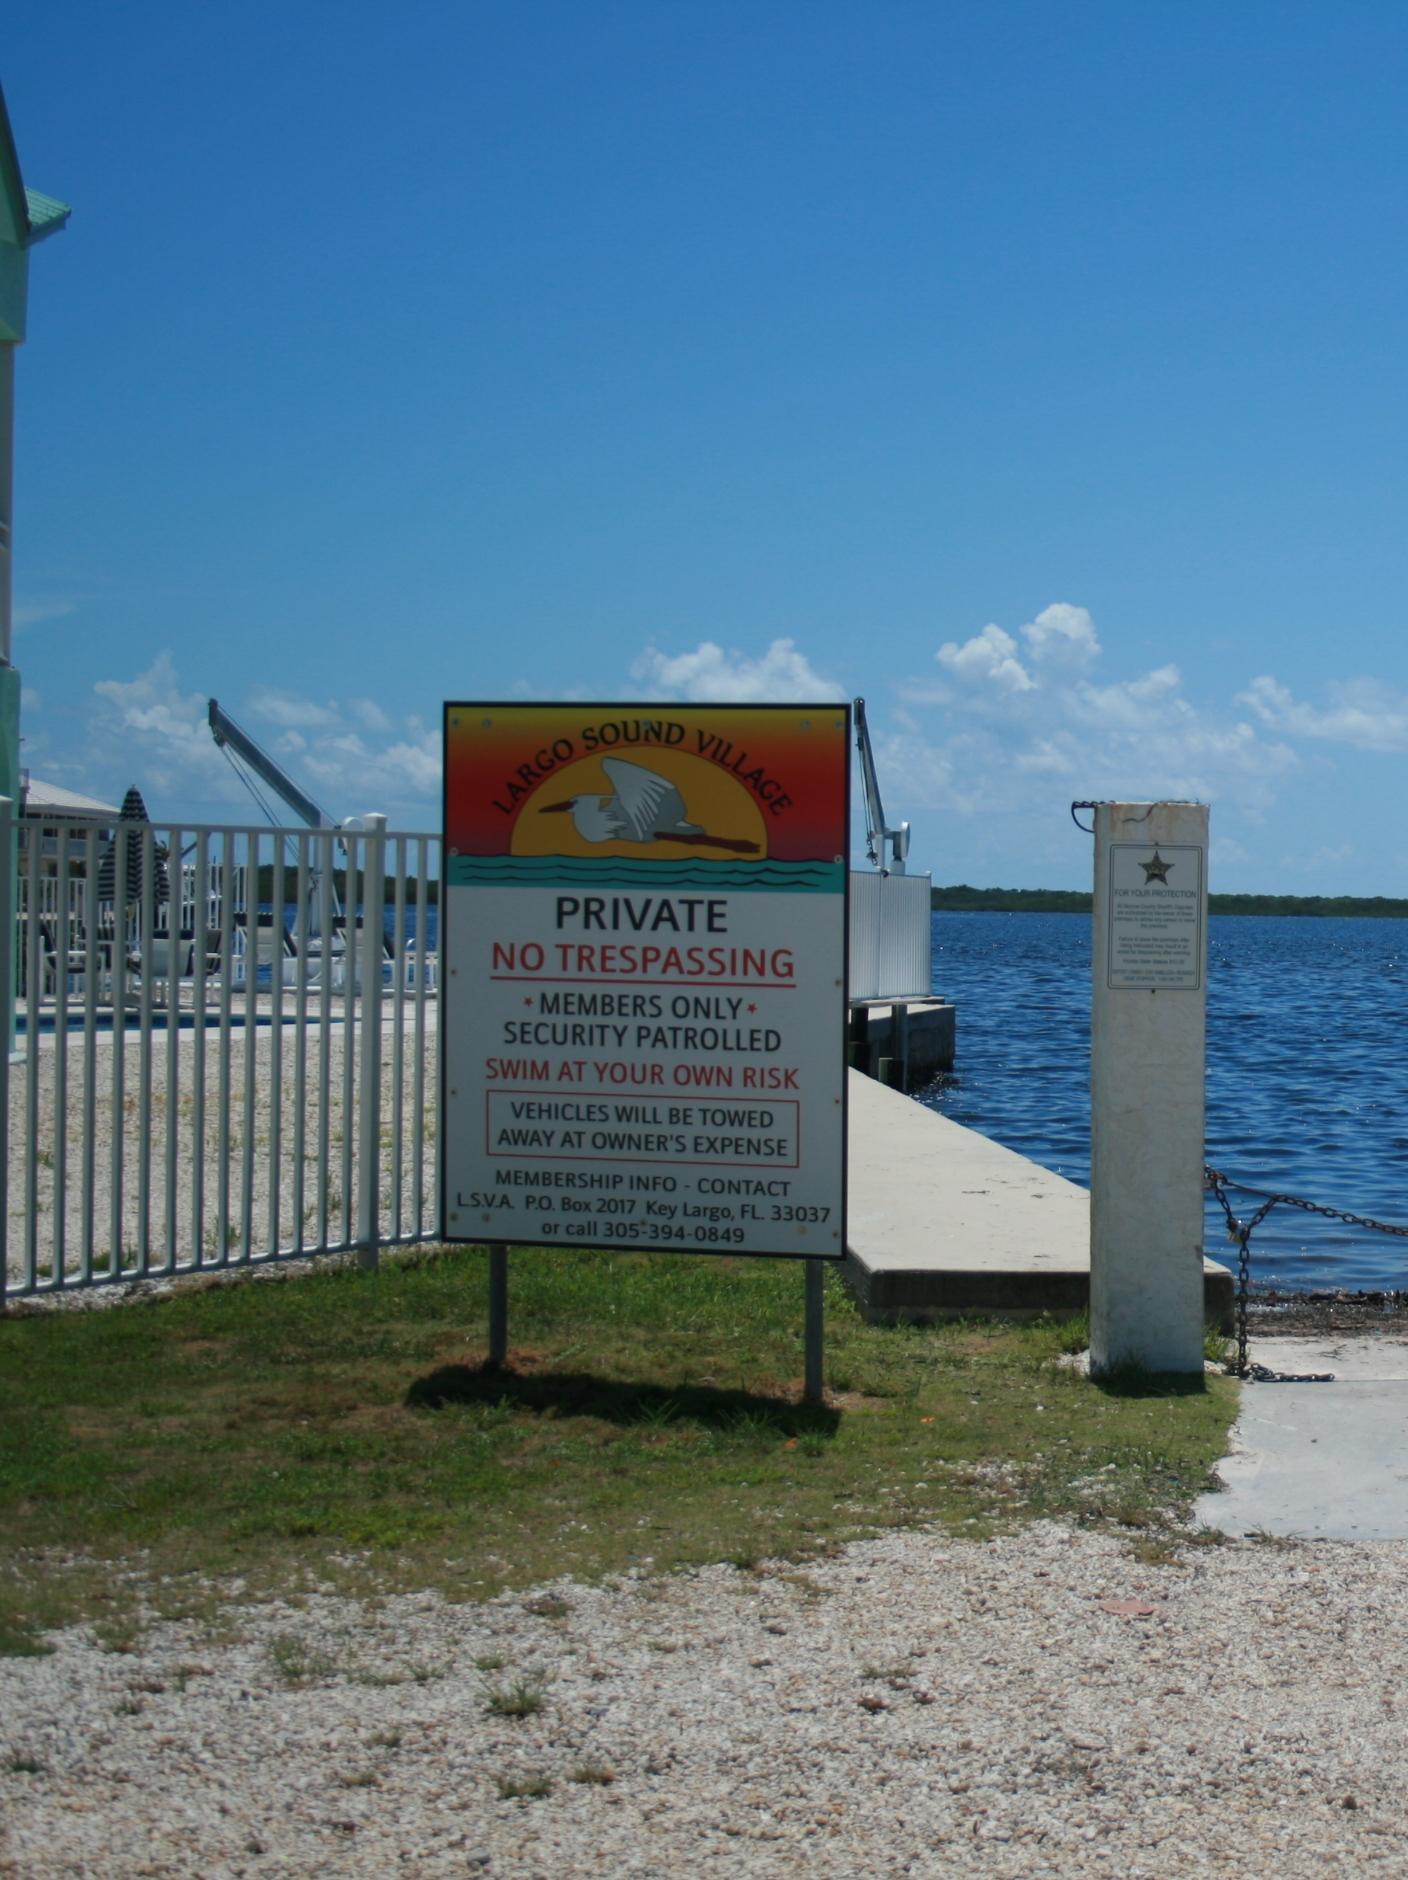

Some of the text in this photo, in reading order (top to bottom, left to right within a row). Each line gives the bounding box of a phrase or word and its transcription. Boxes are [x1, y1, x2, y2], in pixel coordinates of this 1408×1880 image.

[492, 719, 794, 817] LARGO SOUND VILLAGE
[556, 896, 728, 933] PRIVATE
[493, 942, 795, 978] NO TRESPASSING
[540, 992, 744, 1020] MEMBERS ONLY
[504, 1022, 782, 1052] SECURITY PATROLLED
[485, 1058, 800, 1090] SWIM AT YOUR OWN RISK
[511, 1101, 774, 1128] VEHICLES WILL BE TOWED
[497, 1128, 788, 1157] AWAY AT OWNER'S EXPENSE
[495, 1170, 623, 1191] MEMBERSHIP
[630, 1173, 677, 1192] INFO
[698, 1177, 791, 1197] CONTACT
[456, 1192, 831, 1223] L.S.V.A. P.O. Box 2017 Key Largo, FL. 33037
[542, 1220, 745, 1244] or call 305-394-0849
